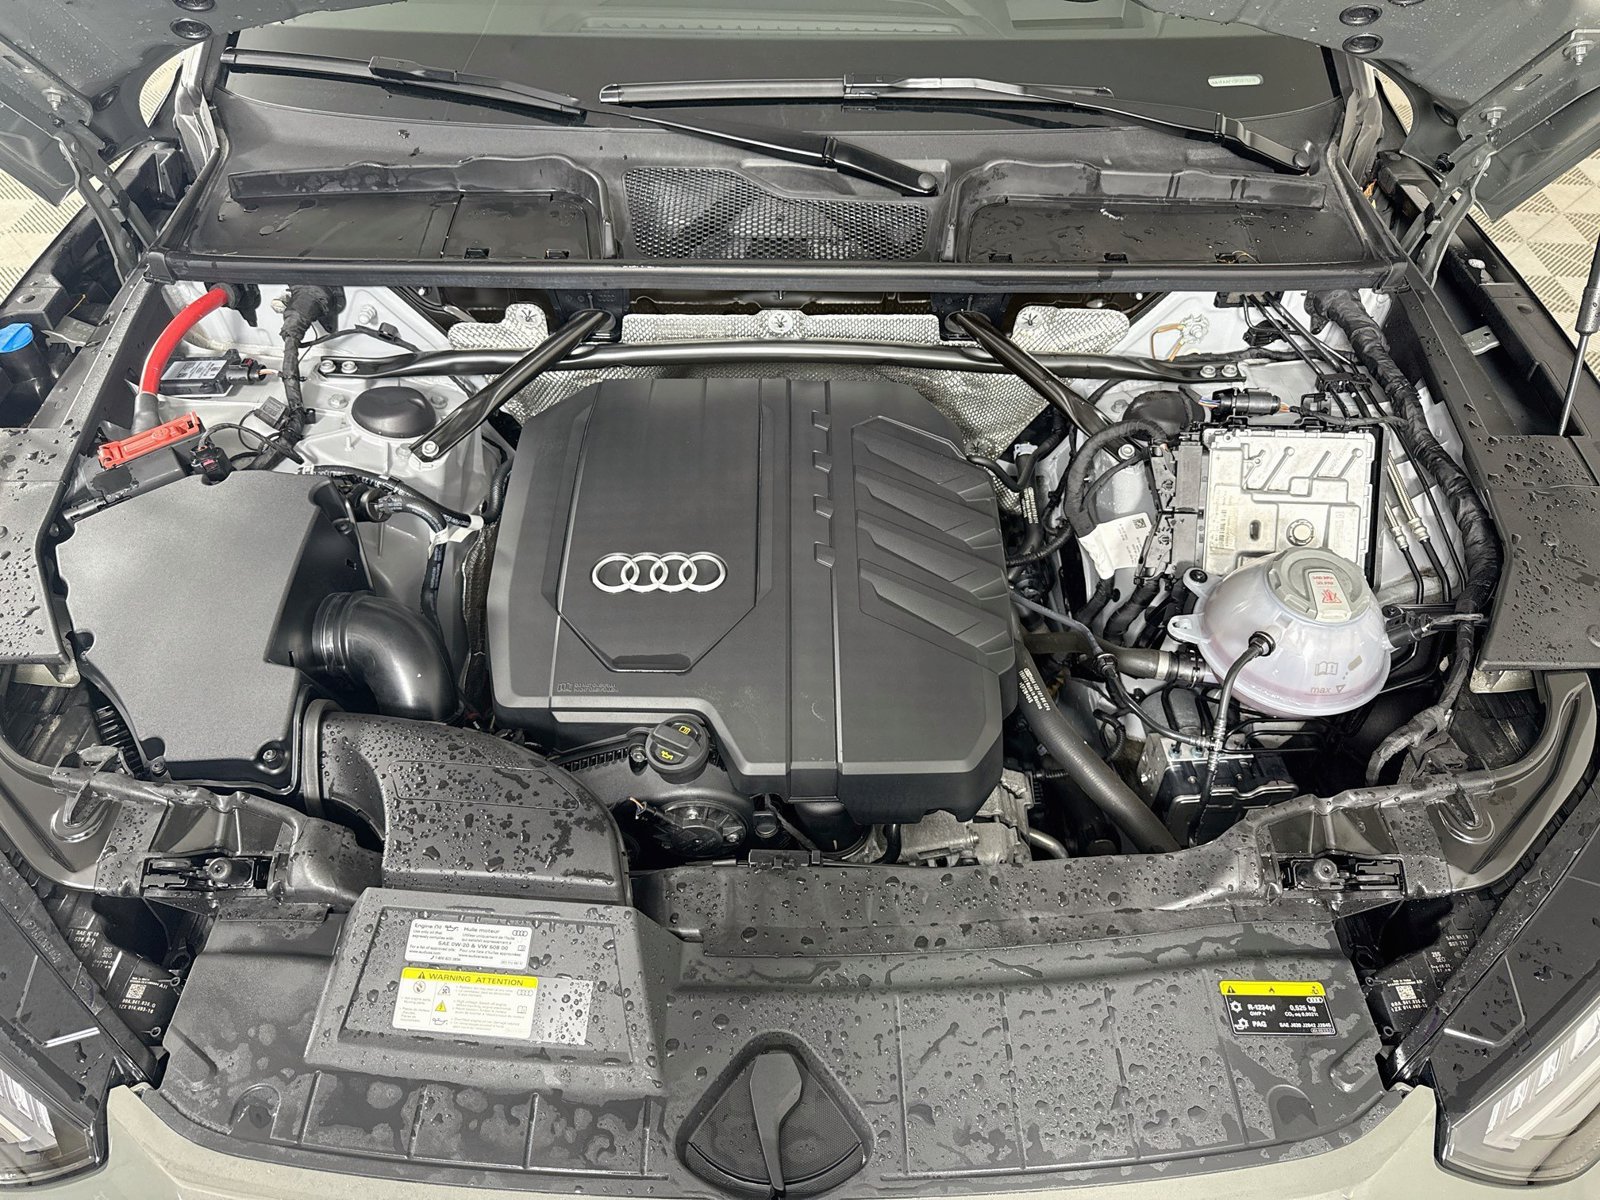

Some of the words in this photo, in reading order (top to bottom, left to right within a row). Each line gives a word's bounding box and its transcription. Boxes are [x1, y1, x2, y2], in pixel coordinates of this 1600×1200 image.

[429, 973, 471, 982] WARNING
[476, 976, 524, 986] ATTENTION
[1247, 1004, 1276, 1012] R-1234yf
